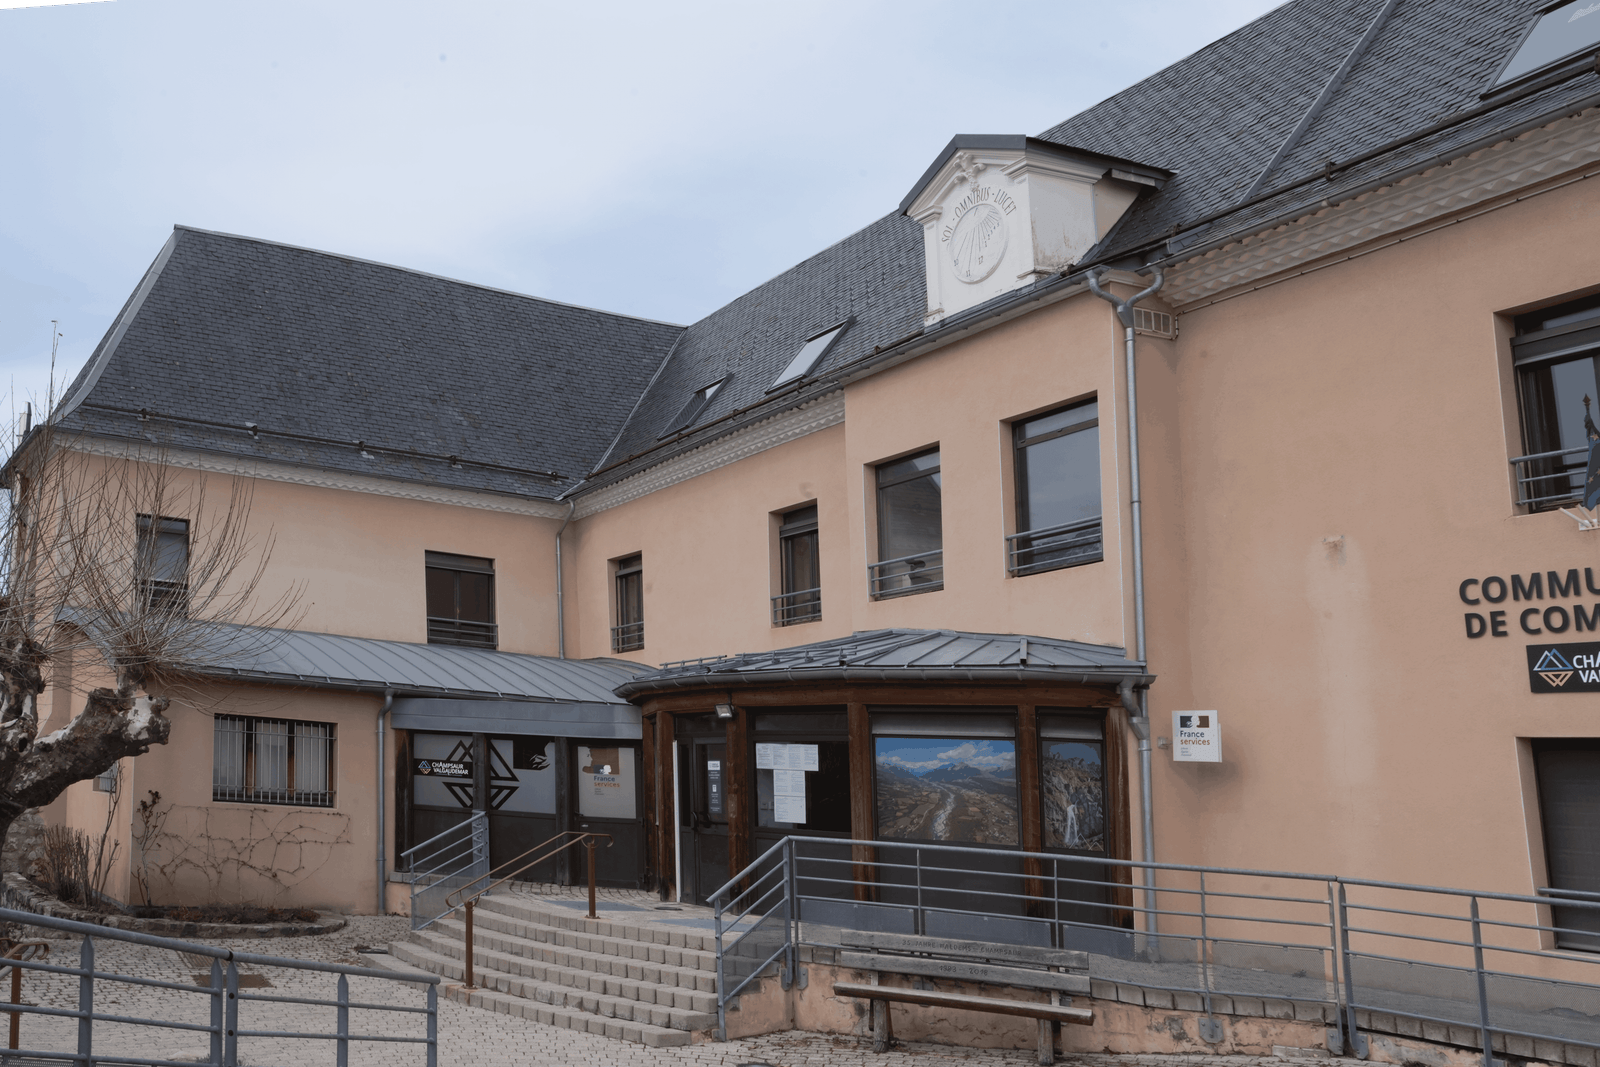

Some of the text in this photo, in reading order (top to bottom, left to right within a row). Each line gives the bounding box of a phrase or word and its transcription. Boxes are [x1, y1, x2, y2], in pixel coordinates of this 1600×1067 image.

[941, 186, 1017, 243] SOL OMNIBUS LUCET
[1459, 567, 1600, 606] COMMU
[1464, 603, 1600, 639] DE COM
[1180, 730, 1205, 738] France
[1180, 738, 1211, 746] services
[980, 946, 1022, 956] CHAMPSAUR
[968, 967, 988, 976] 2018
